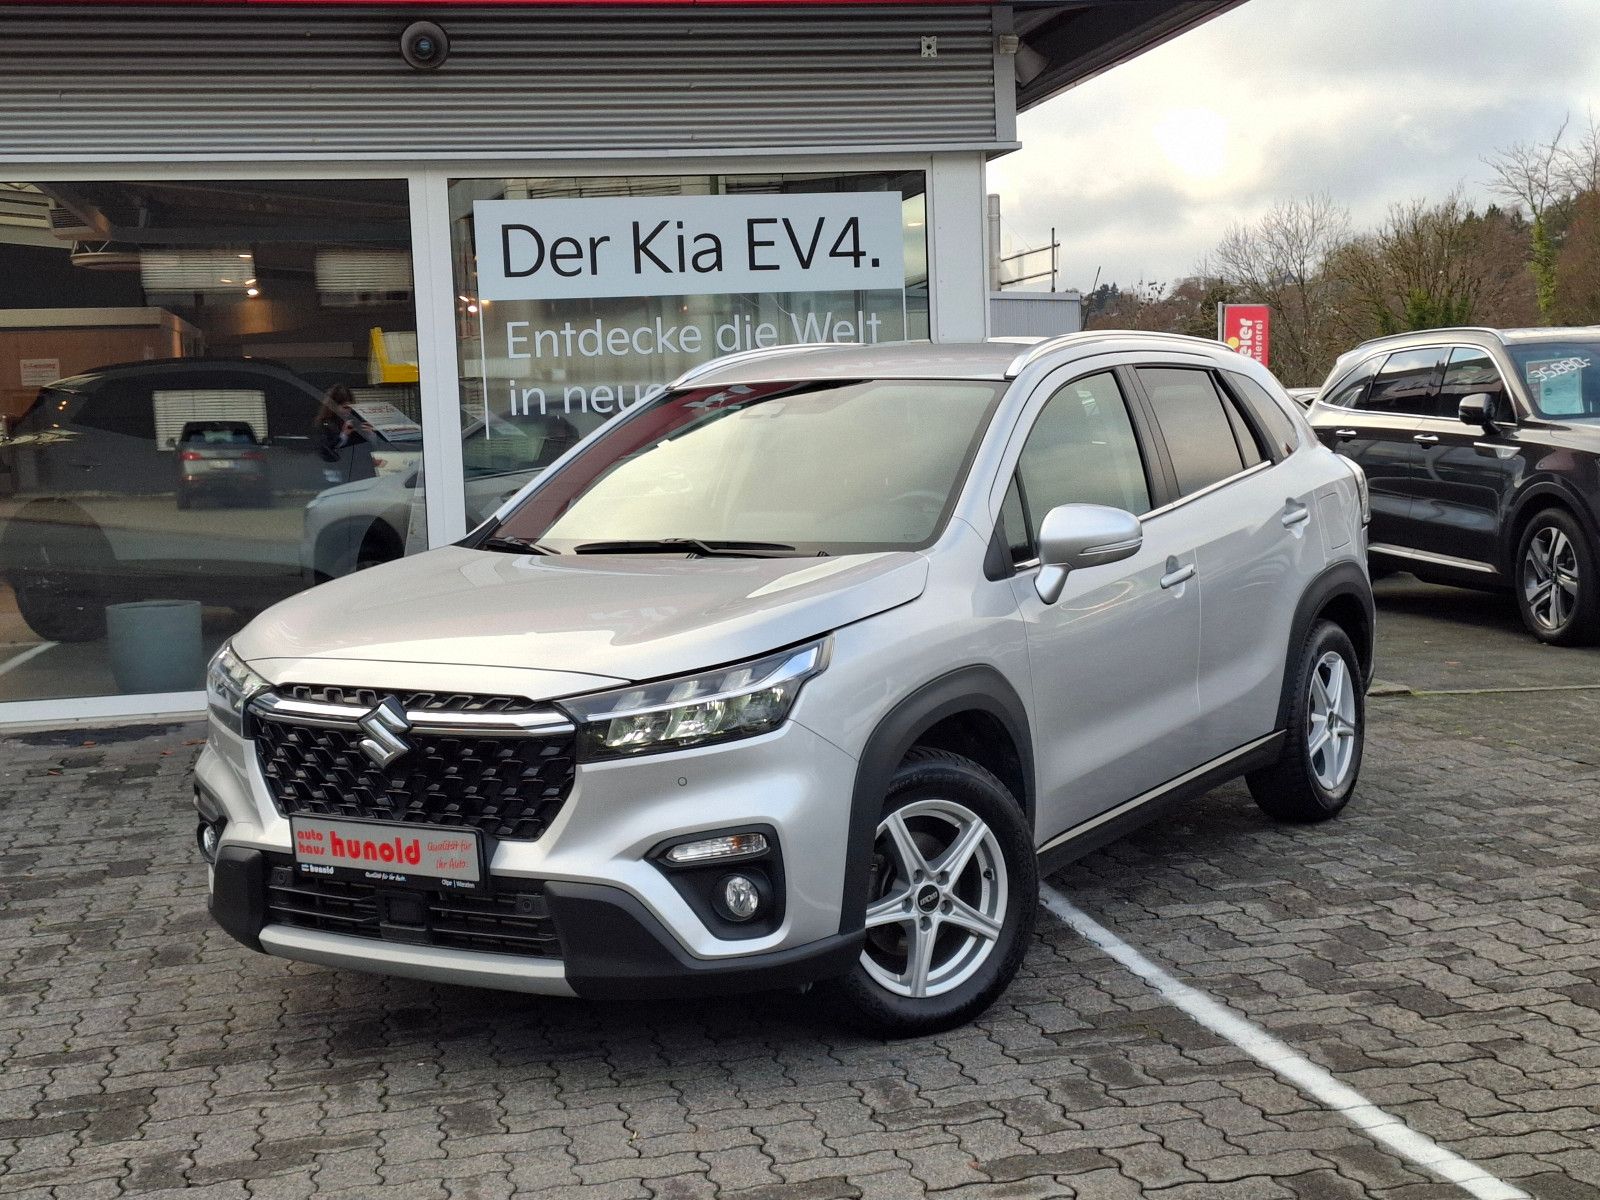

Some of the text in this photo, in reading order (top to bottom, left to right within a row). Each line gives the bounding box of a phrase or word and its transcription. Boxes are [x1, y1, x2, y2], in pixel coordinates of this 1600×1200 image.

[501, 216, 880, 278] Der Kia EV4.
[506, 310, 882, 359] Entdecke die Welt
[509, 379, 547, 416] in
[297, 829, 323, 841] auto
[298, 841, 326, 855] haus
[329, 830, 421, 865] hunold
